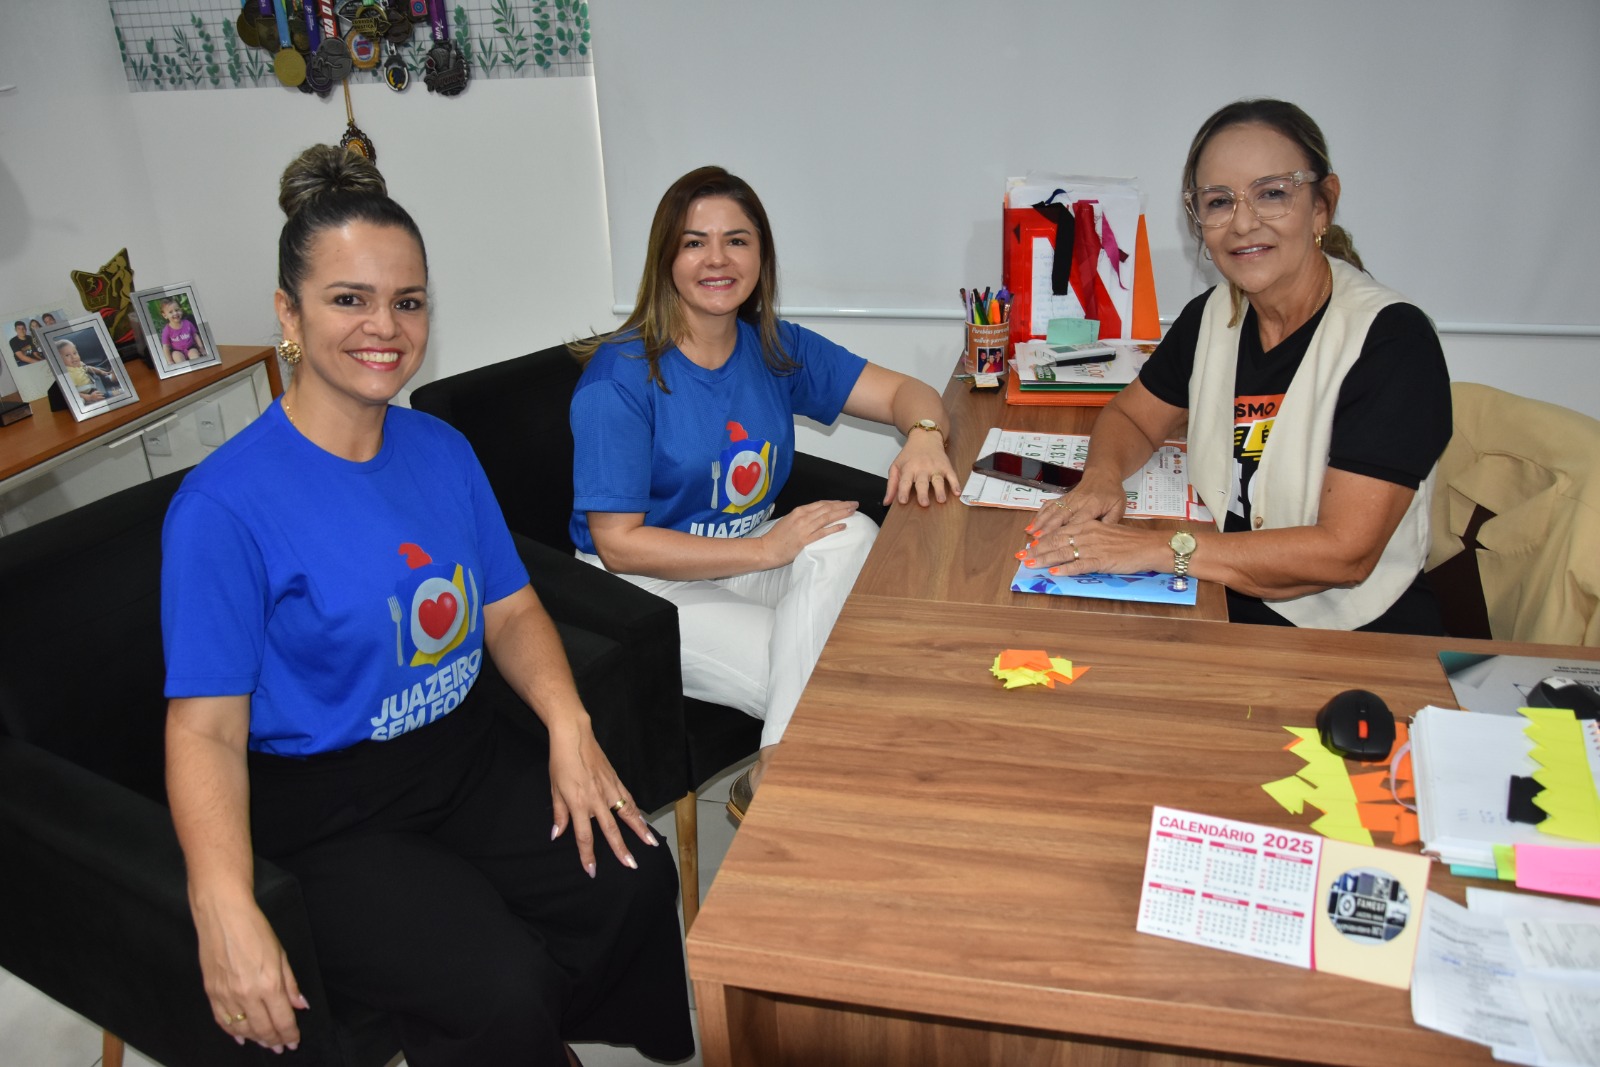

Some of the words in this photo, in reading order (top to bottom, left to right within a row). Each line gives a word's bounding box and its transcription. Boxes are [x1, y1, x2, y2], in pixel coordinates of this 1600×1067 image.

[370, 648, 482, 727] JUAZEIRO
[370, 706, 426, 741] SEM
[429, 670, 480, 723] FOM
[1159, 815, 1255, 844] CALENDÁRIO
[1263, 832, 1314, 854] 2025
